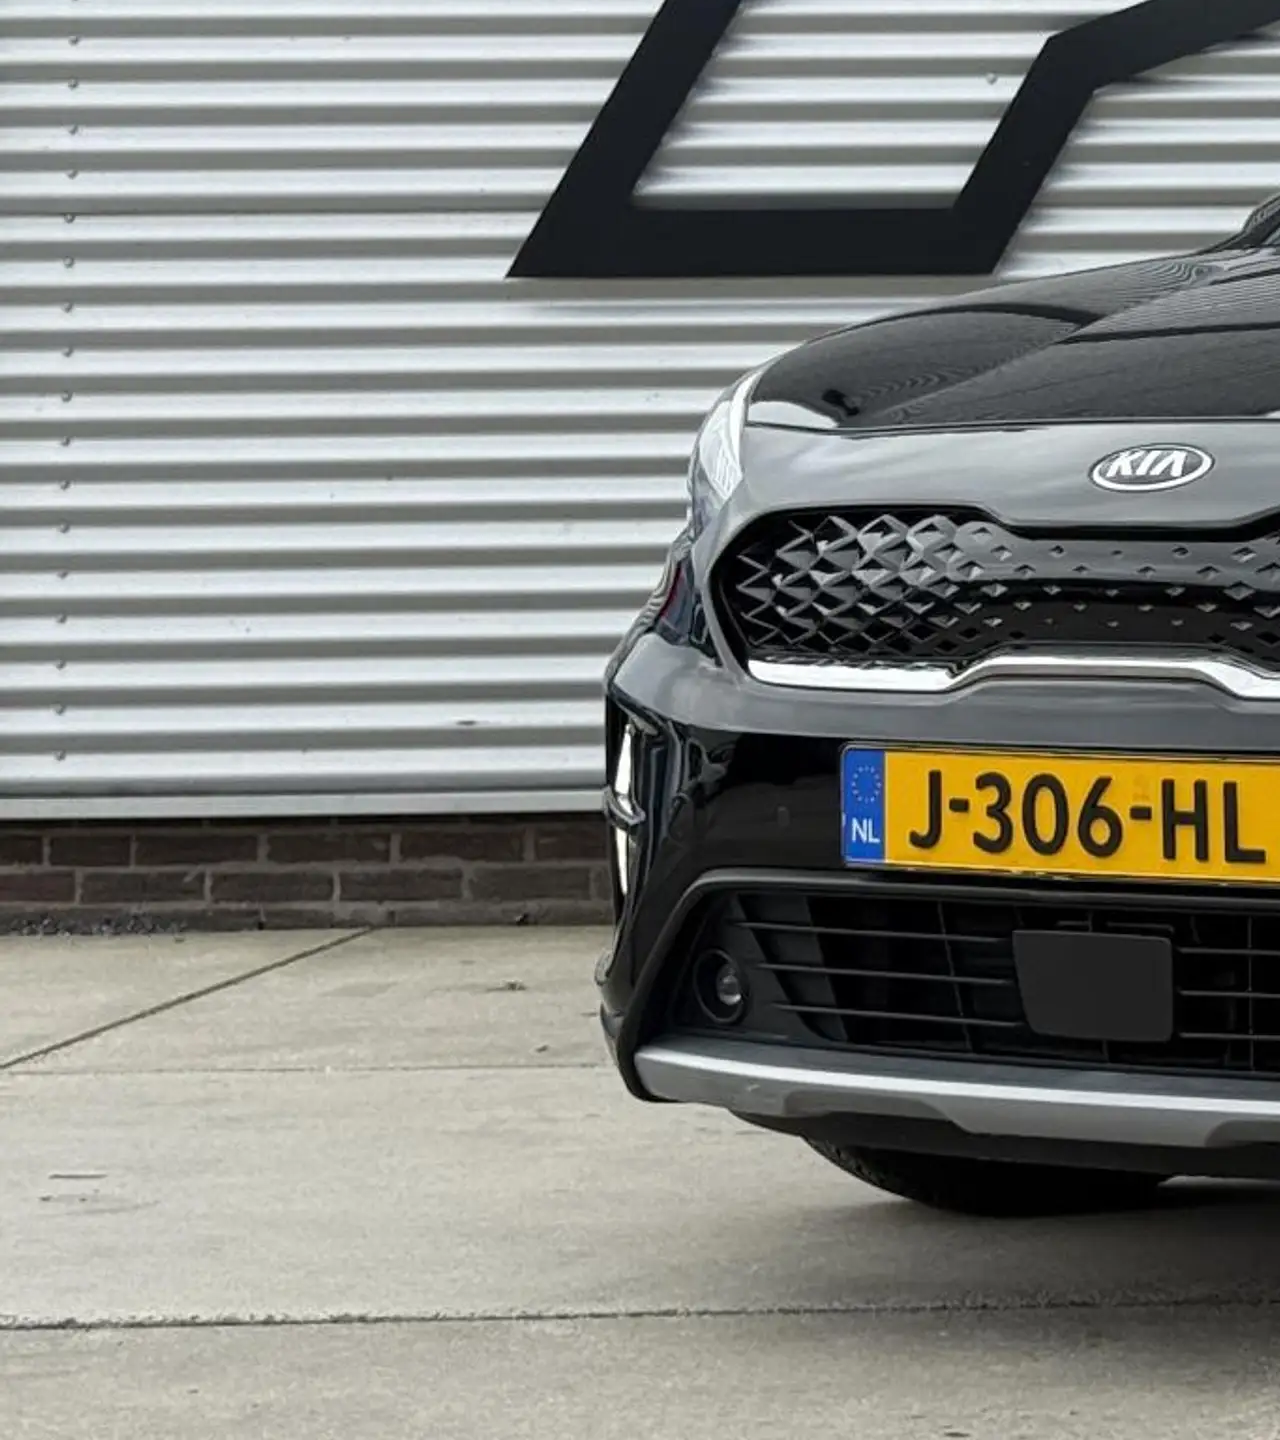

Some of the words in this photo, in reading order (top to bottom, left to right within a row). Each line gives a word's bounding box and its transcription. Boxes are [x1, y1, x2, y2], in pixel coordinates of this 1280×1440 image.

[1105, 449, 1188, 478] KIA
[851, 817, 881, 844] NL
[908, 769, 1267, 864] J-306-HL
